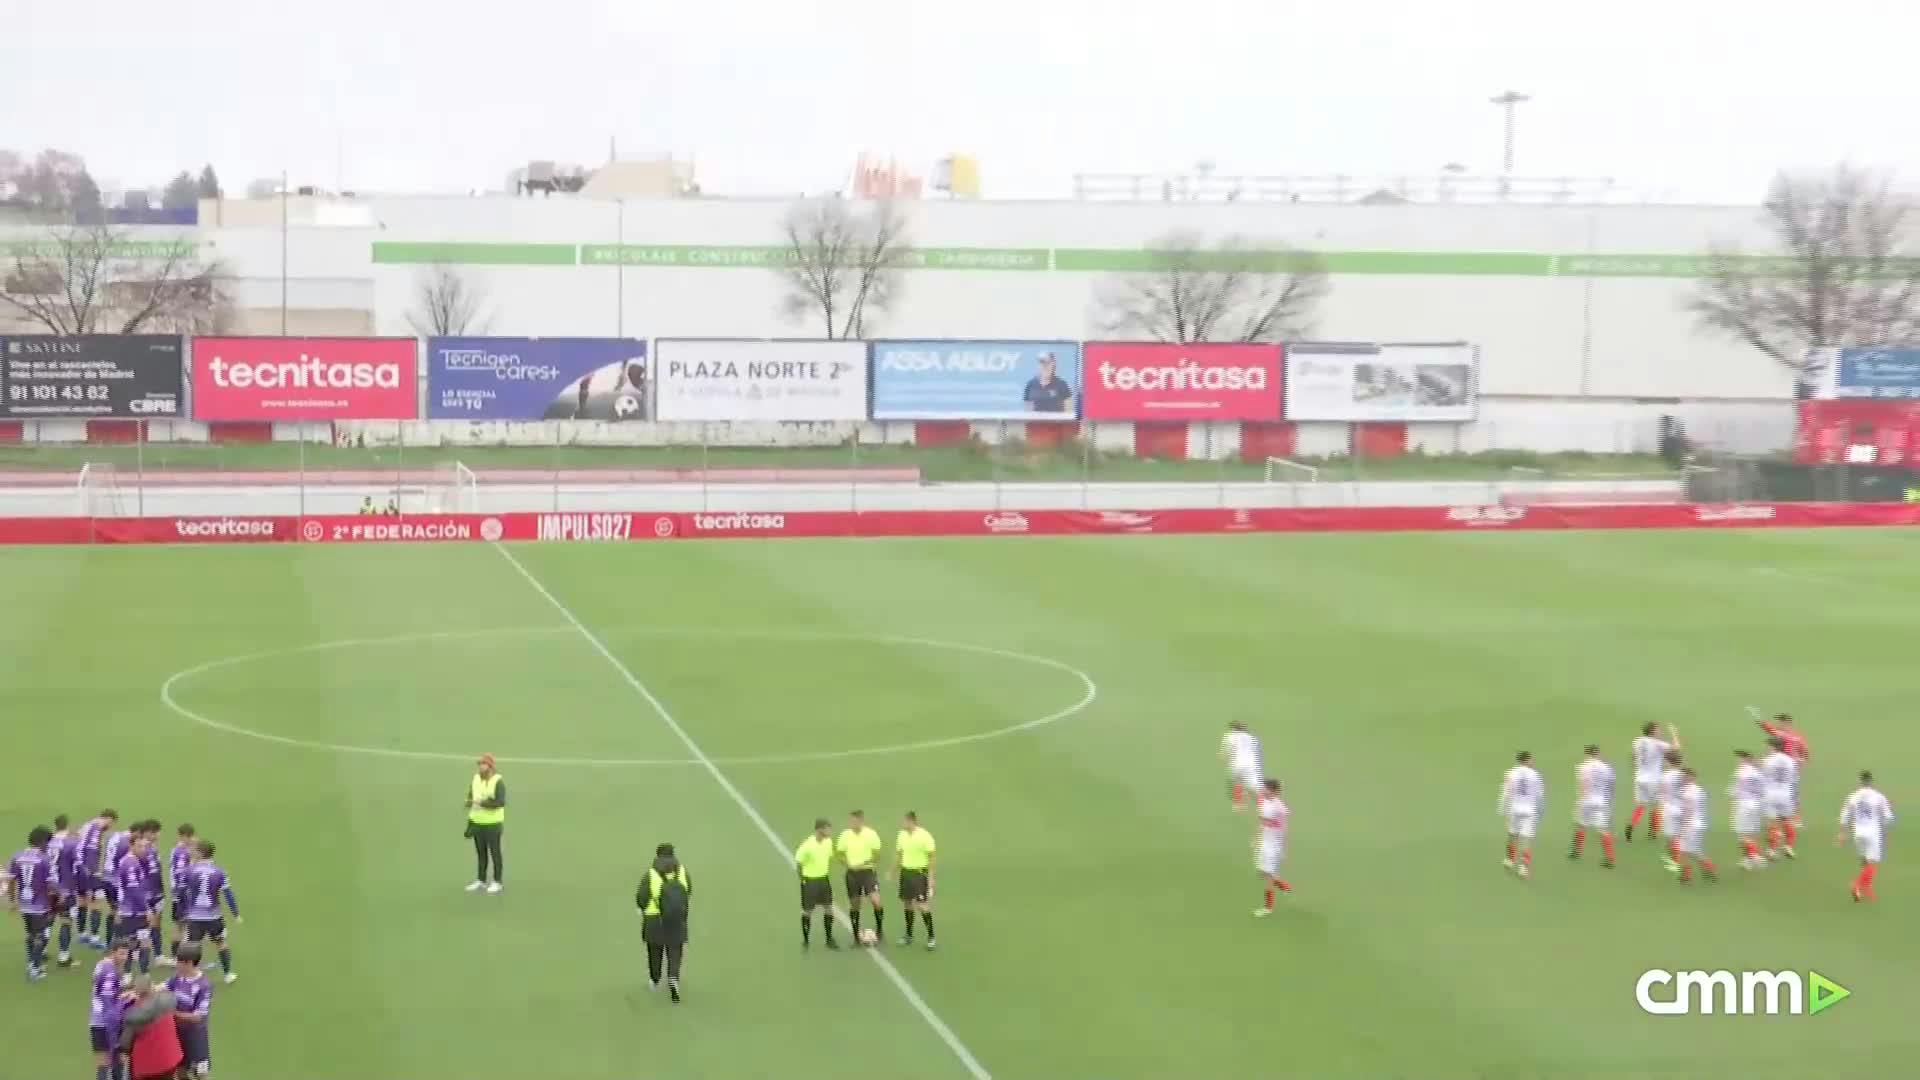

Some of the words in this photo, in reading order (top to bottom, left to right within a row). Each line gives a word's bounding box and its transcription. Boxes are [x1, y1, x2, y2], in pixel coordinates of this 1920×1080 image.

[26, 343, 81, 353] SKYLINE
[439, 349, 521, 369] Tecnigen
[882, 351, 944, 370] ASSA
[946, 351, 1022, 370] ABLOY
[208, 353, 400, 388] tecnitasa
[495, 364, 560, 380] cares+
[669, 361, 739, 379] PLAZA
[748, 361, 821, 379] NORTE
[1099, 358, 1268, 390] tecnitasa
[9, 385, 28, 400] 91
[32, 385, 57, 400] 101
[61, 385, 83, 400] 43
[129, 399, 176, 413] CBRE
[175, 517, 274, 535] tecnitasa
[353, 520, 471, 539] FEDERACIÓN
[536, 514, 633, 540] IMPULSO27
[694, 512, 784, 529] tecnitasa
